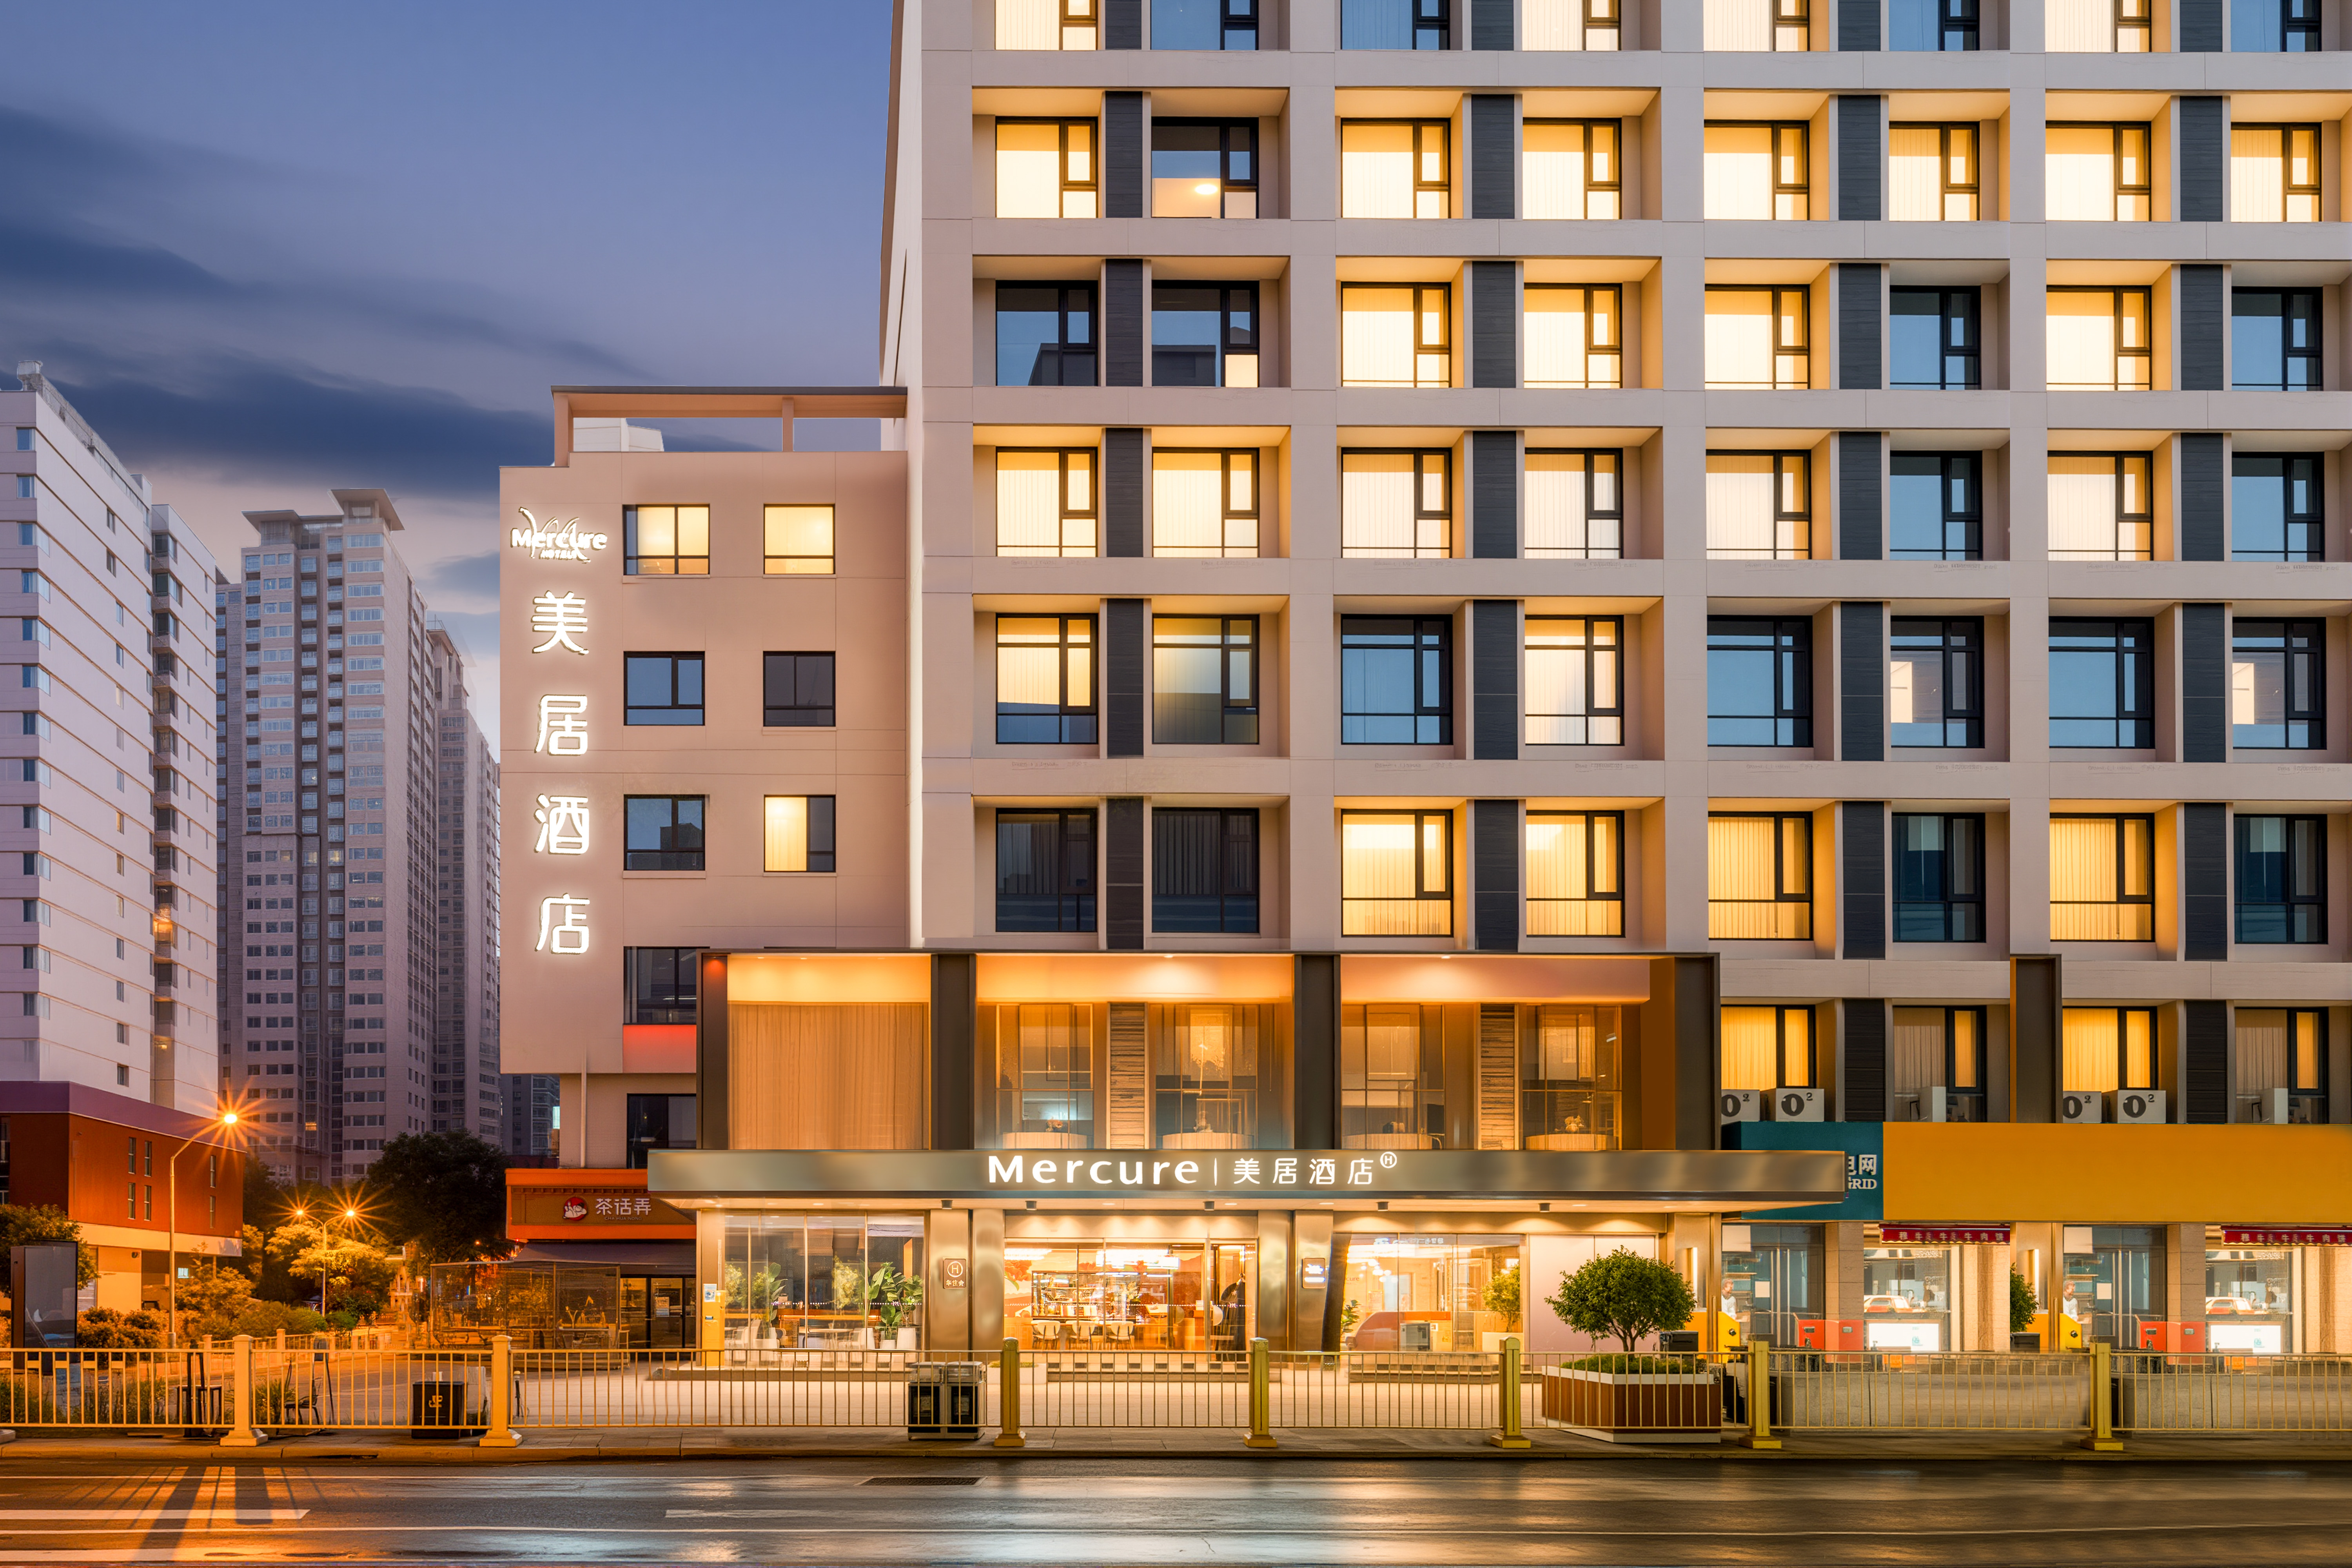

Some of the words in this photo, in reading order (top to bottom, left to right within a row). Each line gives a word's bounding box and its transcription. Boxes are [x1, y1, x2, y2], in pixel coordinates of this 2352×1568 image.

[510, 528, 608, 550] Mercure
[531, 590, 590, 955] 美居酒店
[989, 1155, 1199, 1184] Mercure
[1234, 1158, 1374, 1185] 美居酒店
[595, 1198, 652, 1215] 茶话弄
